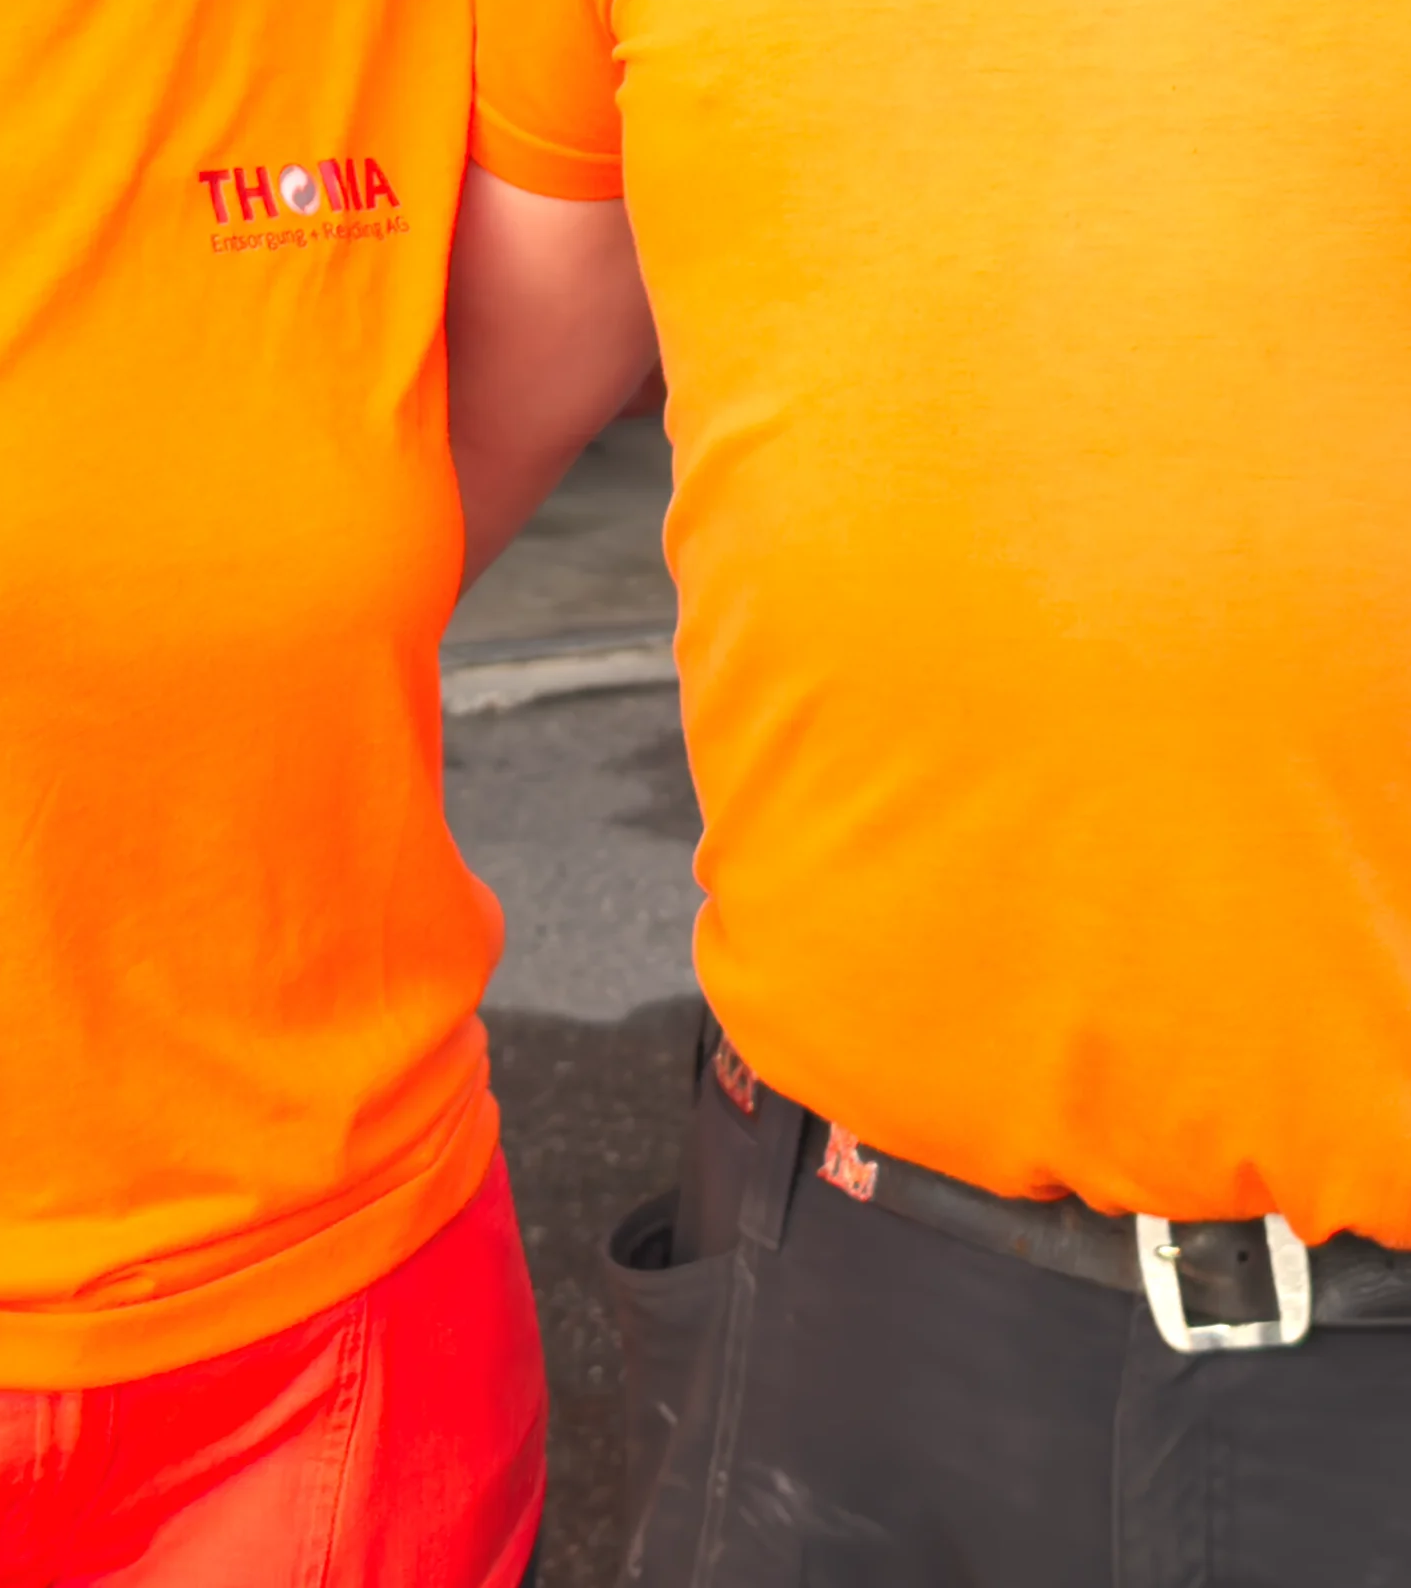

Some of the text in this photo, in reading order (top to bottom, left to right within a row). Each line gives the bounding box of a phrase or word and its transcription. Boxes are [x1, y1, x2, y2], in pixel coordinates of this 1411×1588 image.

[199, 157, 400, 224] THOMA
[210, 228, 308, 253] Entsorgung
[386, 215, 410, 235] AG
